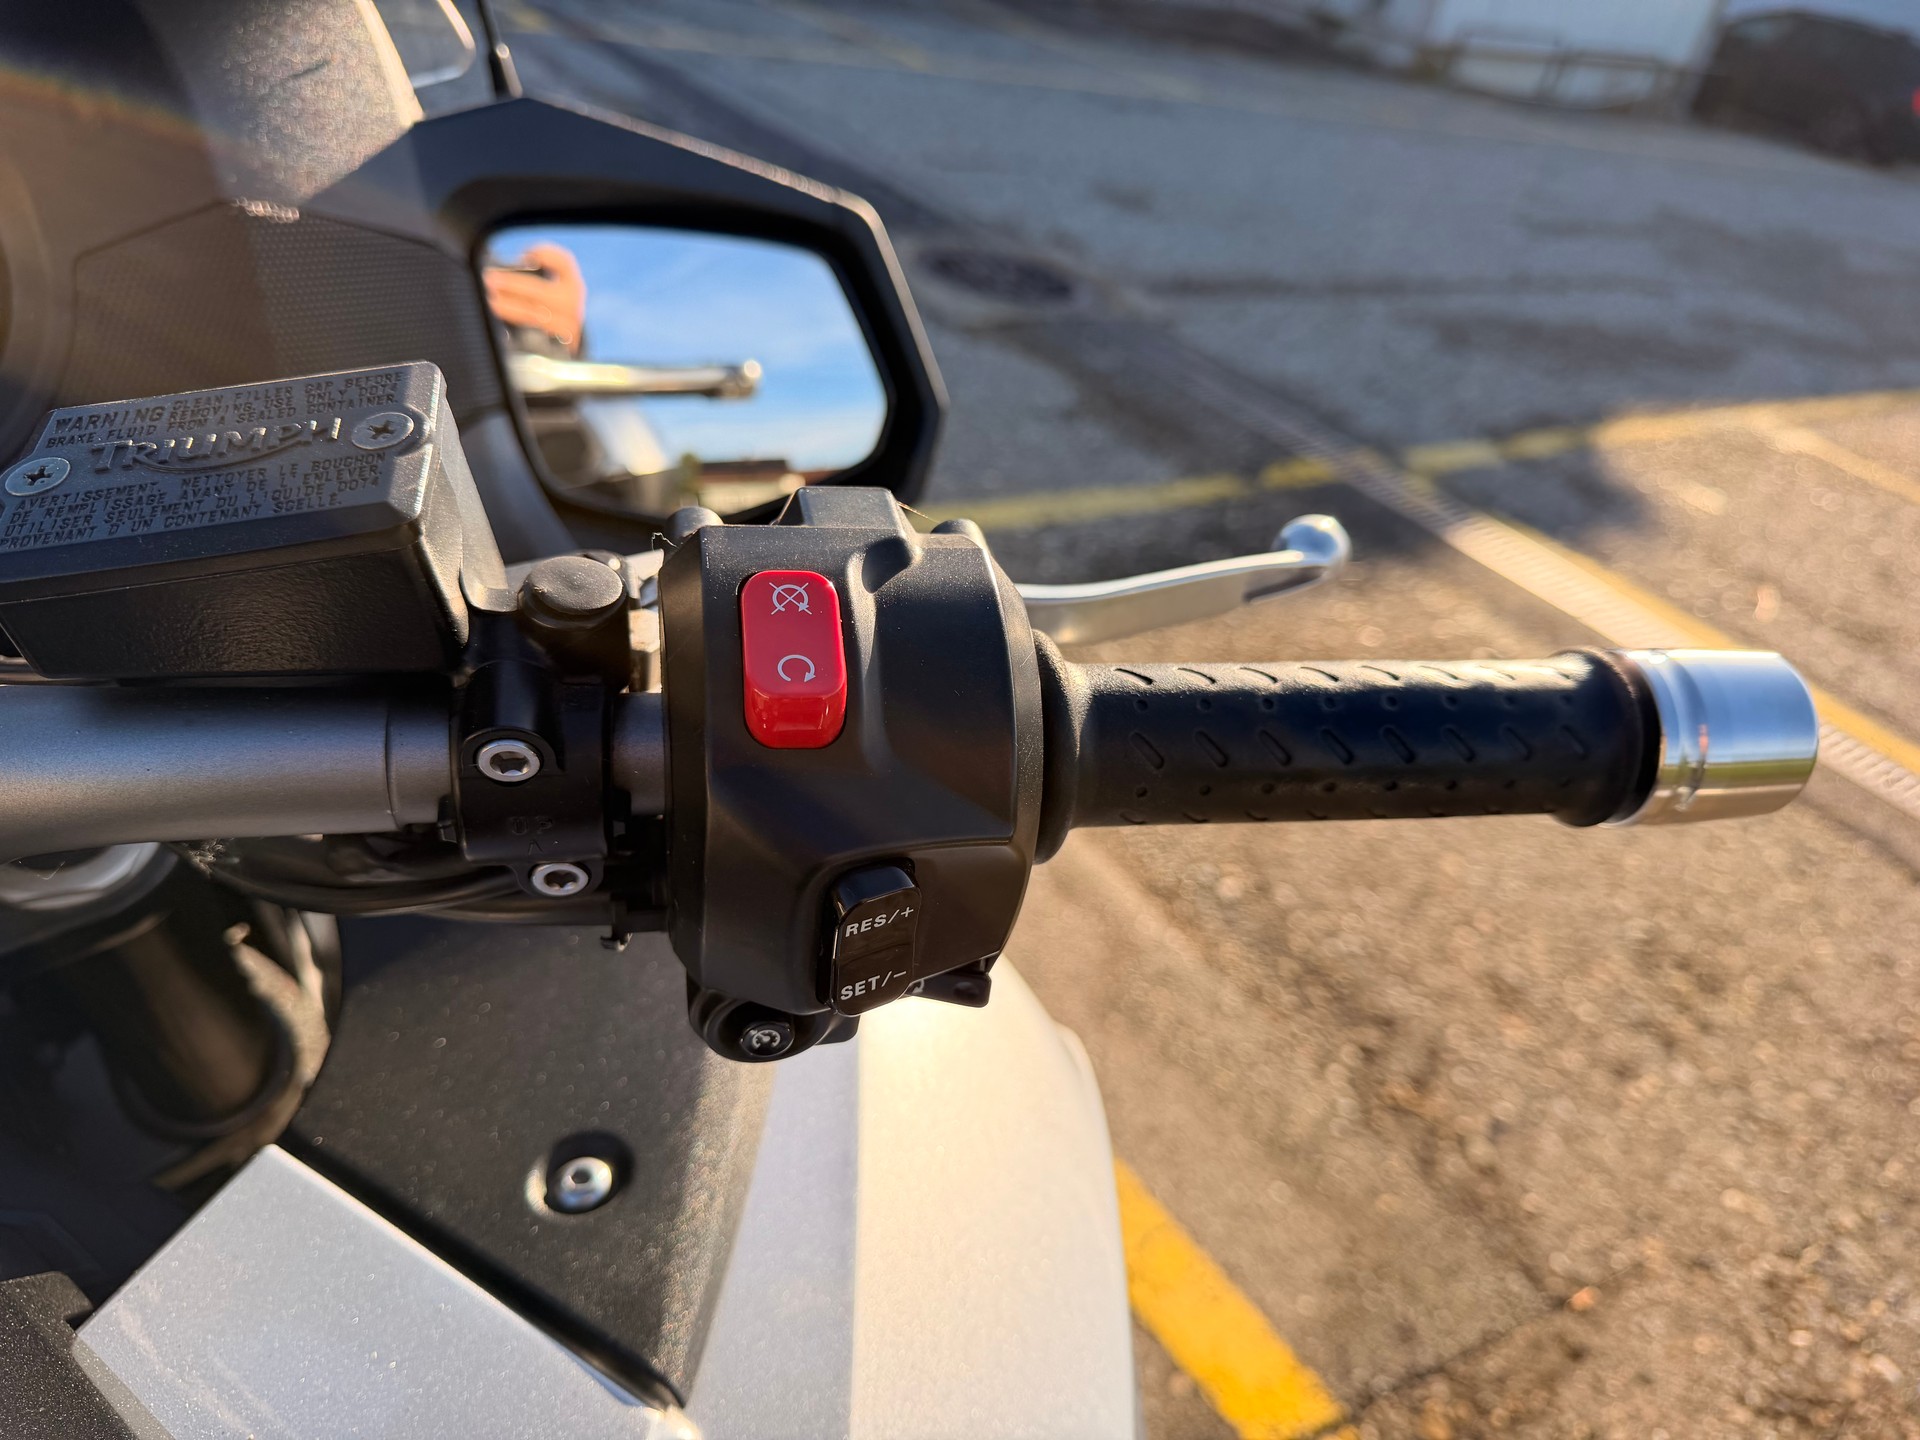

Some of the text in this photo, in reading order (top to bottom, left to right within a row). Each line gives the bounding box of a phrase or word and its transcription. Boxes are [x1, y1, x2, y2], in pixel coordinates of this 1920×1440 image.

[54, 371, 403, 433] WARNING CLEAN FILLER CAP BEFORE
[264, 398, 294, 409] USE
[306, 390, 347, 404] ONLY
[45, 432, 96, 448] BRAKE
[107, 425, 158, 439] FLUID
[167, 417, 208, 432] FROM
[217, 415, 226, 425] A
[236, 407, 297, 424] SEALED
[92, 417, 342, 474] TRIUMPH
[181, 467, 267, 488] NETTOYER
[279, 463, 299, 478] LE
[311, 452, 386, 472] BOUCHON
[4, 515, 93, 537] UTILISER
[103, 499, 205, 525] SEULEMENT
[216, 495, 238, 509] DU
[250, 483, 326, 505] LIQUIDE
[10, 510, 33, 524] DE
[180, 483, 234, 501] AVANT
[247, 479, 267, 493] DE
[0, 526, 98, 549] PROVENANT
[164, 504, 262, 528] CONTENANT
[844, 906, 914, 938] RES/+
